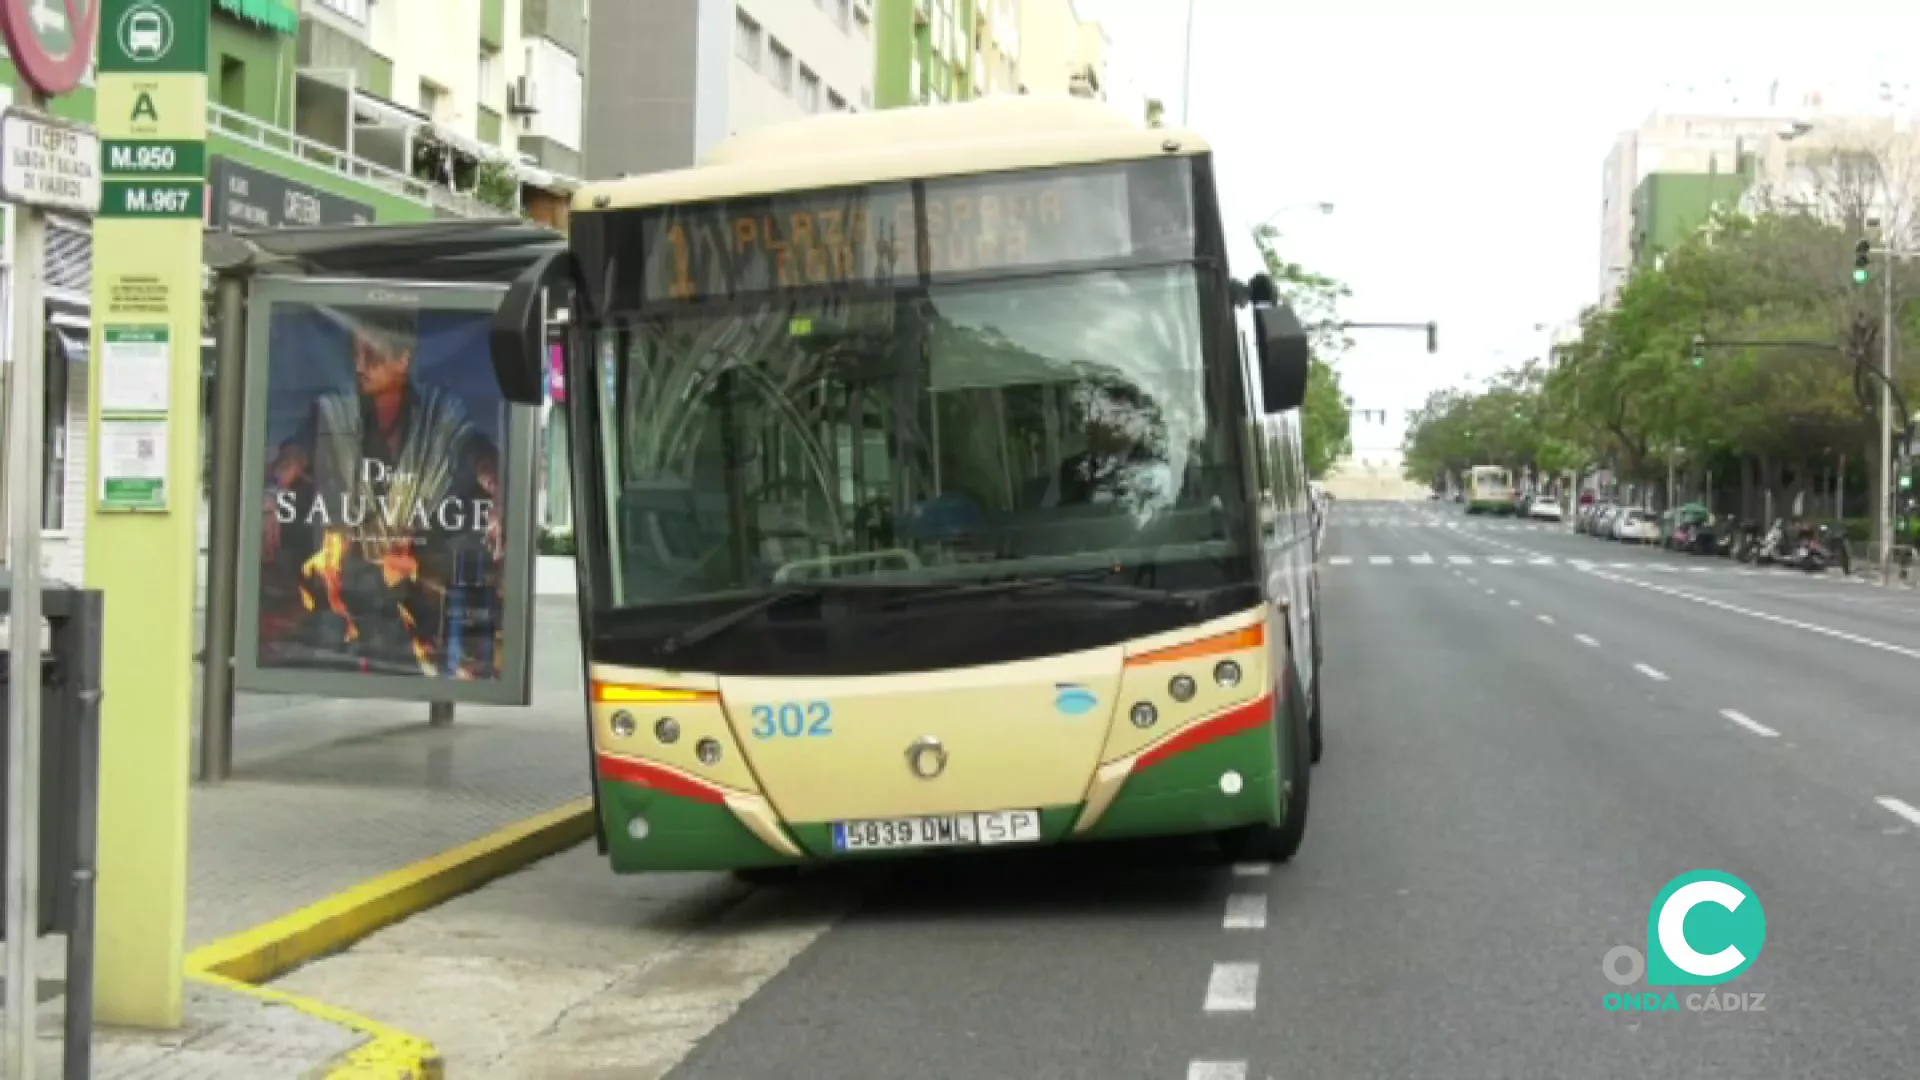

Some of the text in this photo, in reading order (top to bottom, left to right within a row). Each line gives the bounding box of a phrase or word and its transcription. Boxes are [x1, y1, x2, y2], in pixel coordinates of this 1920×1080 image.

[130, 90, 159, 122] A
[111, 145, 175, 170] M.950
[127, 187, 190, 212] M.967
[733, 207, 868, 254] PLAZA
[361, 457, 417, 484] Dior
[275, 489, 494, 533] SAUVAGE
[751, 700, 833, 739] 302
[849, 819, 912, 847] 5839
[985, 811, 1032, 841] SP
